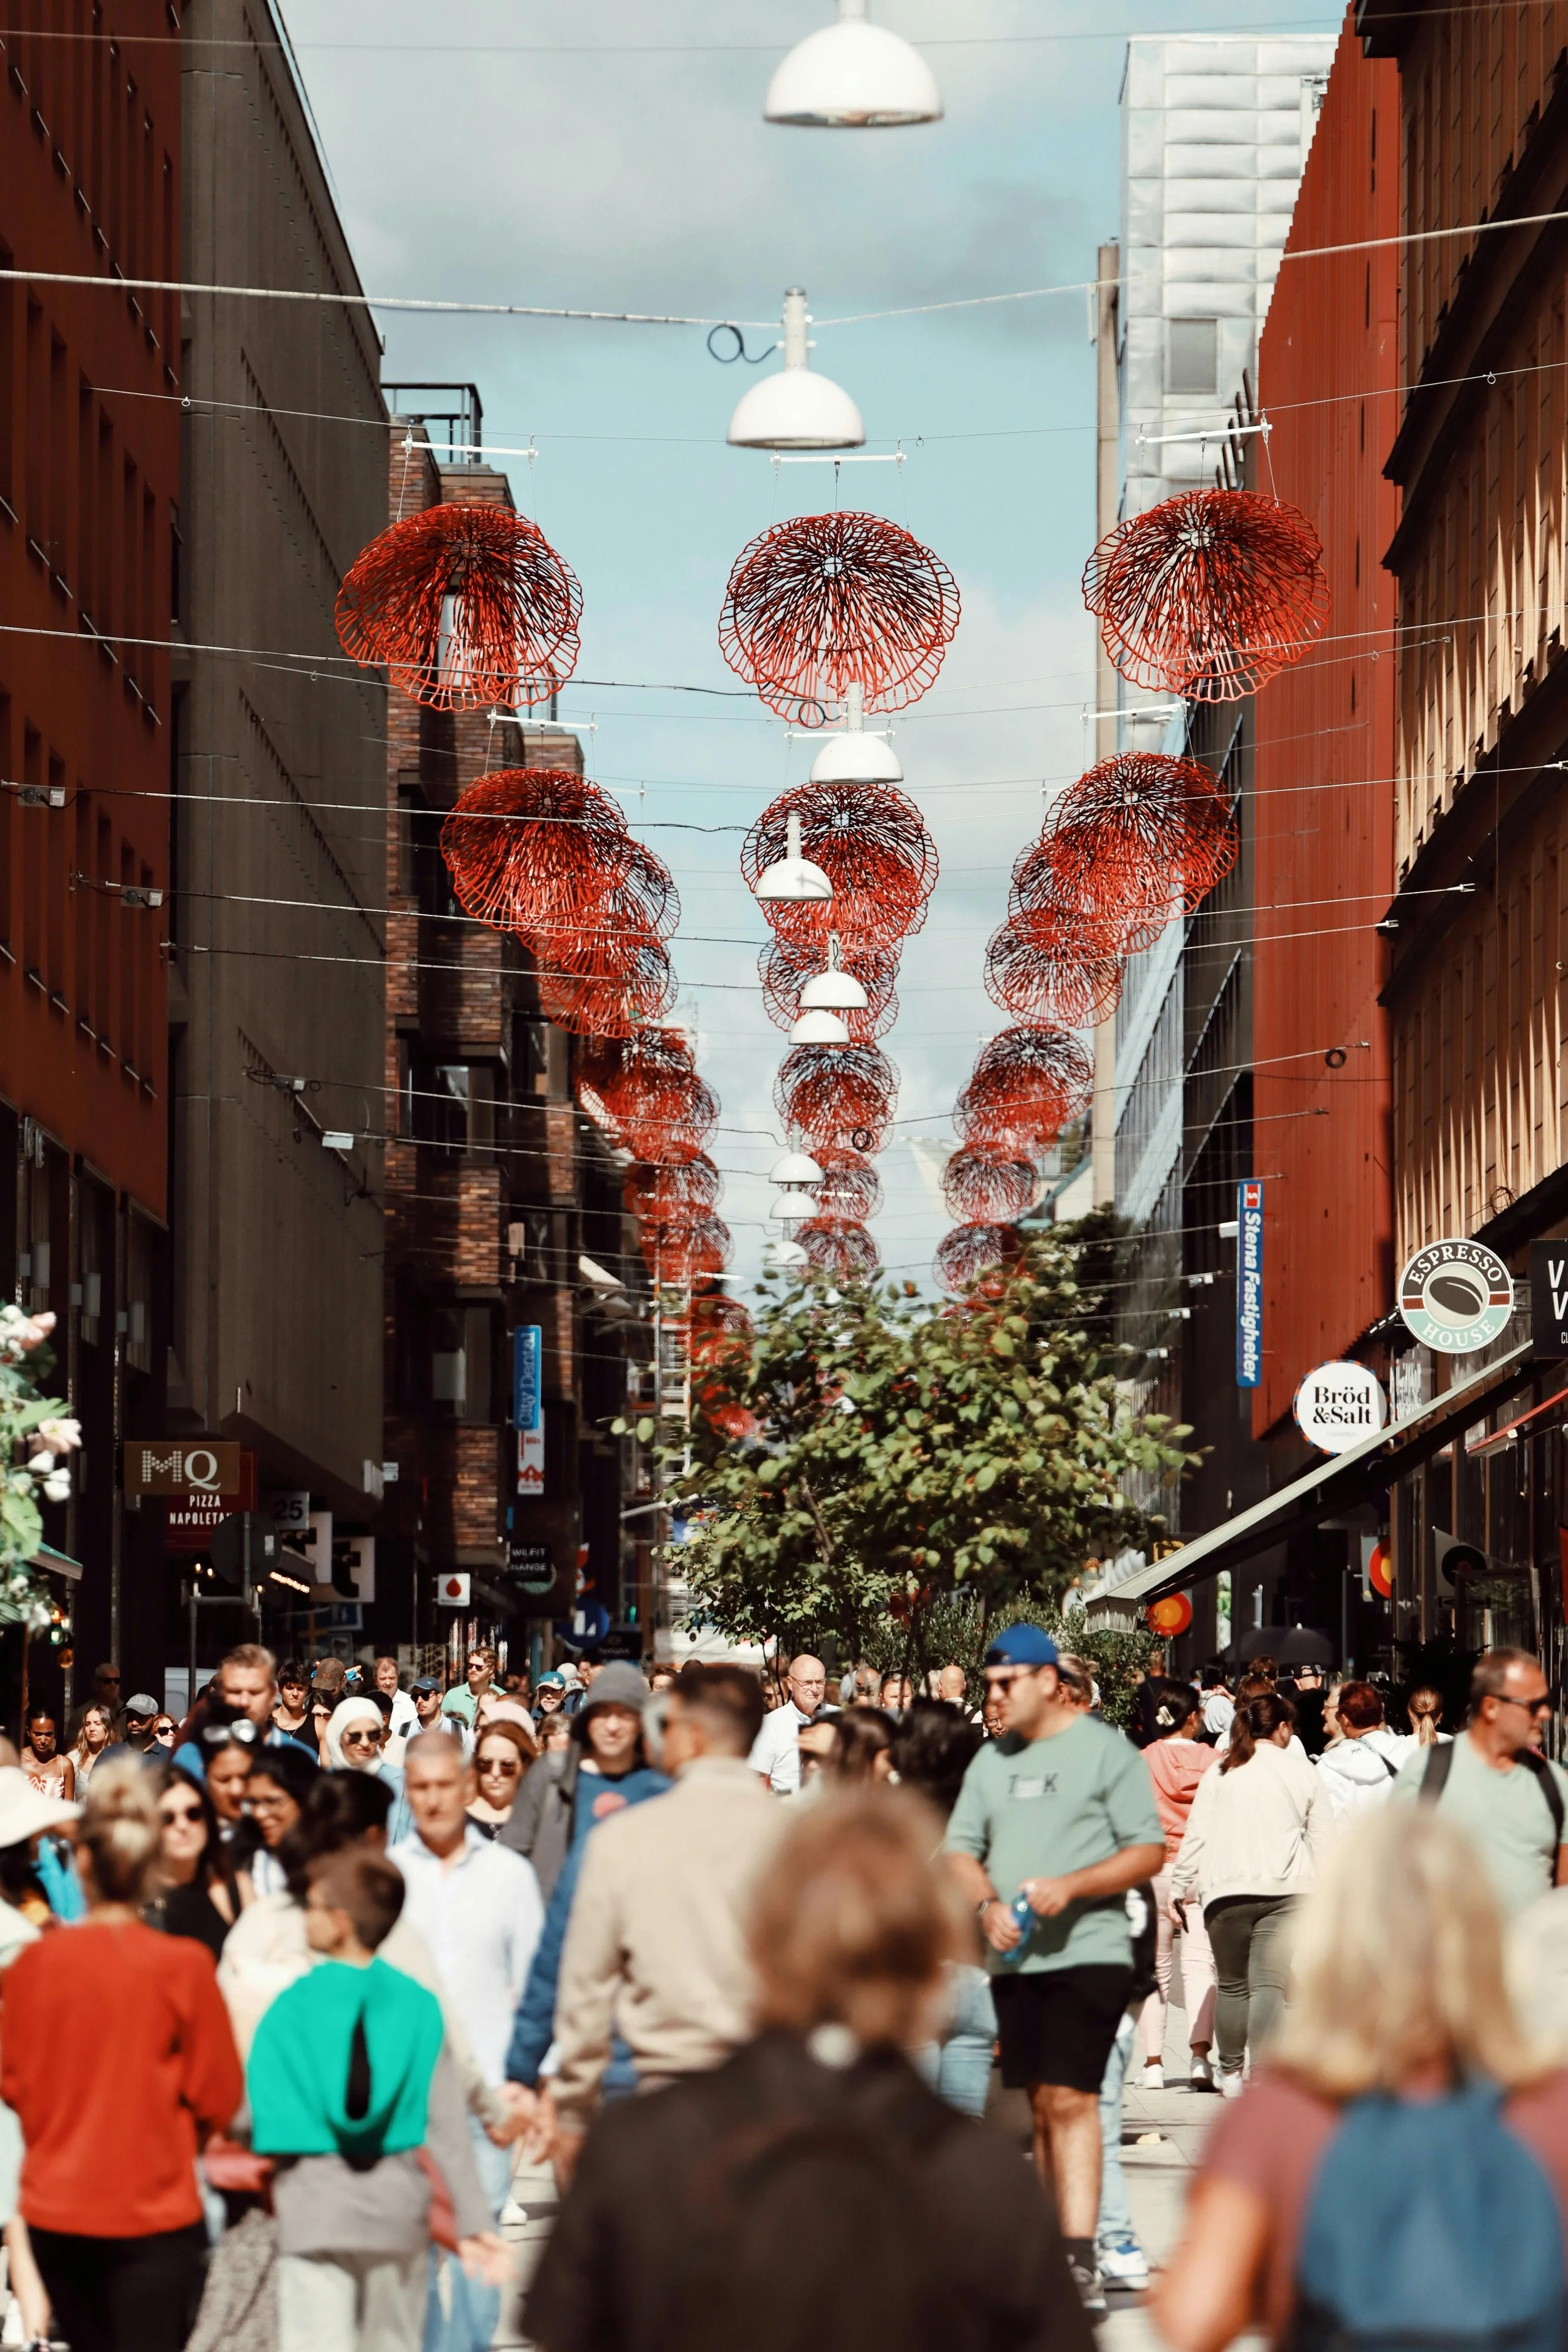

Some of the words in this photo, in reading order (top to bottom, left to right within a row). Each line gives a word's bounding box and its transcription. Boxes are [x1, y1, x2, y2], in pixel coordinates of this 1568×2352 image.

[1244, 1210, 1261, 1269] Stena
[1409, 1244, 1502, 1285] ESPRESSO
[1240, 1270, 1261, 1382] Fastigheter
[1422, 1319, 1495, 1347] HOUSE
[519, 1331, 536, 1389] Dental
[518, 1392, 536, 1426] City
[1313, 1386, 1370, 1404] Bröd
[1313, 1406, 1373, 1424] &Salt
[142, 1449, 221, 1491] MQ
[189, 1495, 221, 1508] PIZZA
[273, 1500, 303, 1521] 25
[169, 1512, 233, 1525] NAPOLETA
